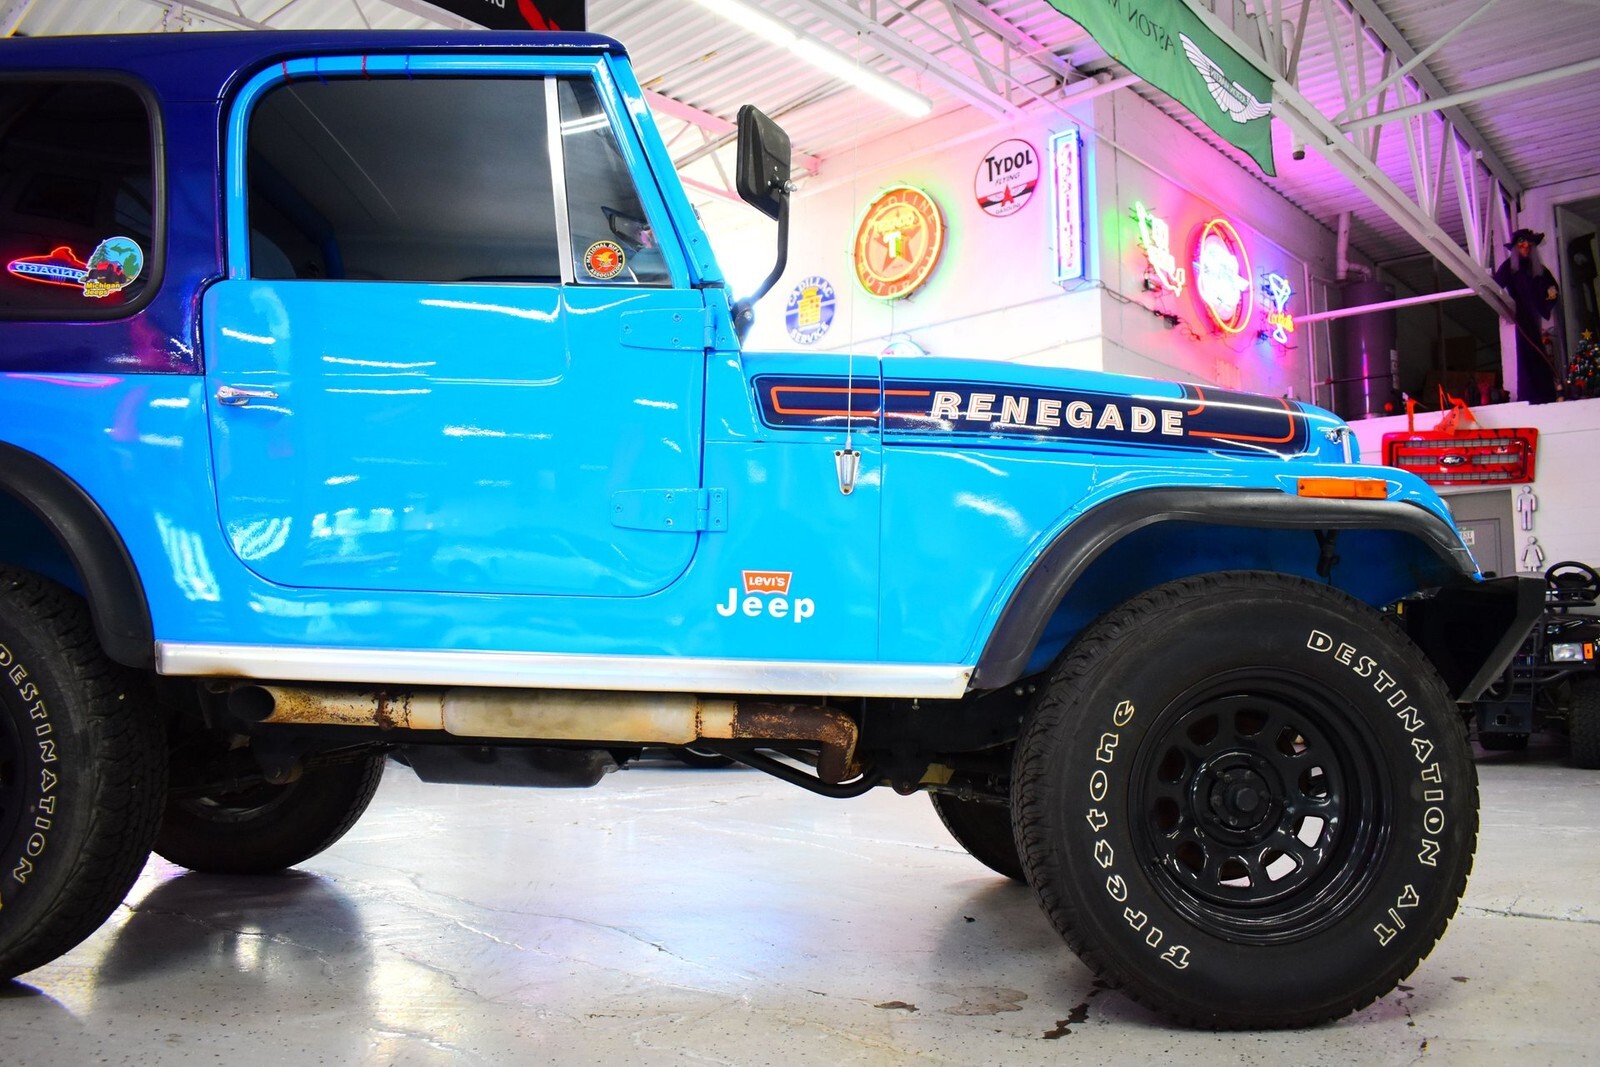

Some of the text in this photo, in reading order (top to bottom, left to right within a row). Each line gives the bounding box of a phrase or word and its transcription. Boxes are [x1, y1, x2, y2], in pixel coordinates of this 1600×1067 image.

[985, 149, 1032, 182] TYDOL
[586, 243, 608, 263] NATIONAL
[86, 281, 121, 290] Michigan
[930, 391, 1184, 437] RENEGADE
[716, 587, 815, 623] Jeep
[0, 643, 57, 884] DESTINATION
[1306, 629, 1445, 867] DESTINATION
[1086, 700, 1190, 970] Firestone
[1373, 884, 1420, 947] A/T
